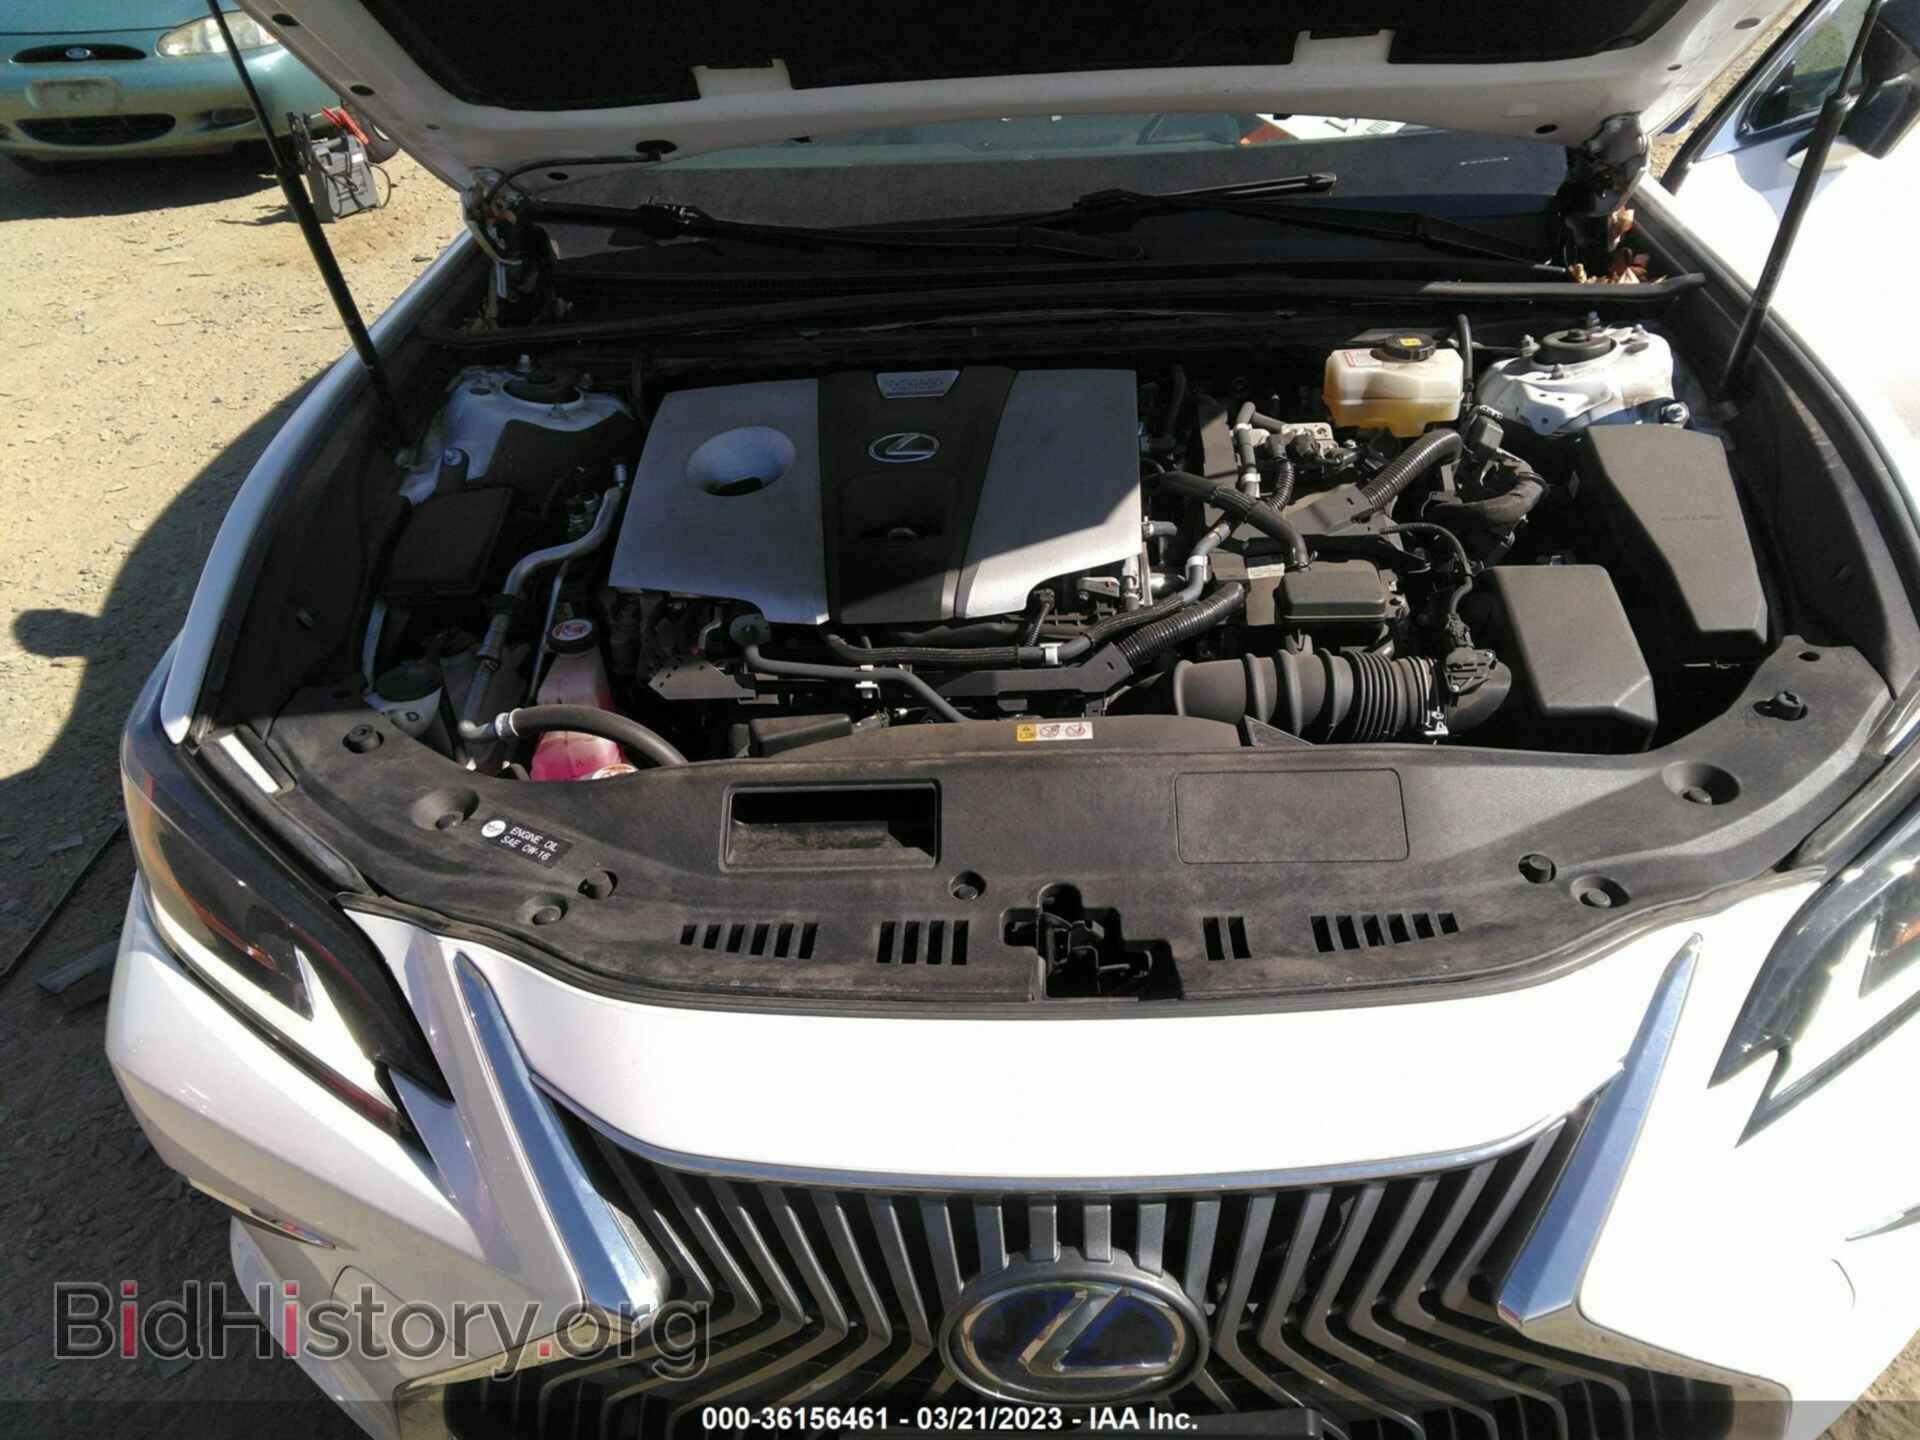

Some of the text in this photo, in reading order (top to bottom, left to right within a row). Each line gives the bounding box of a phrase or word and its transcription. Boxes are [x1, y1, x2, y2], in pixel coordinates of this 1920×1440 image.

[500, 835, 522, 848] SAE
[509, 826, 543, 845] ENGINE
[543, 840, 559, 853] OIL
